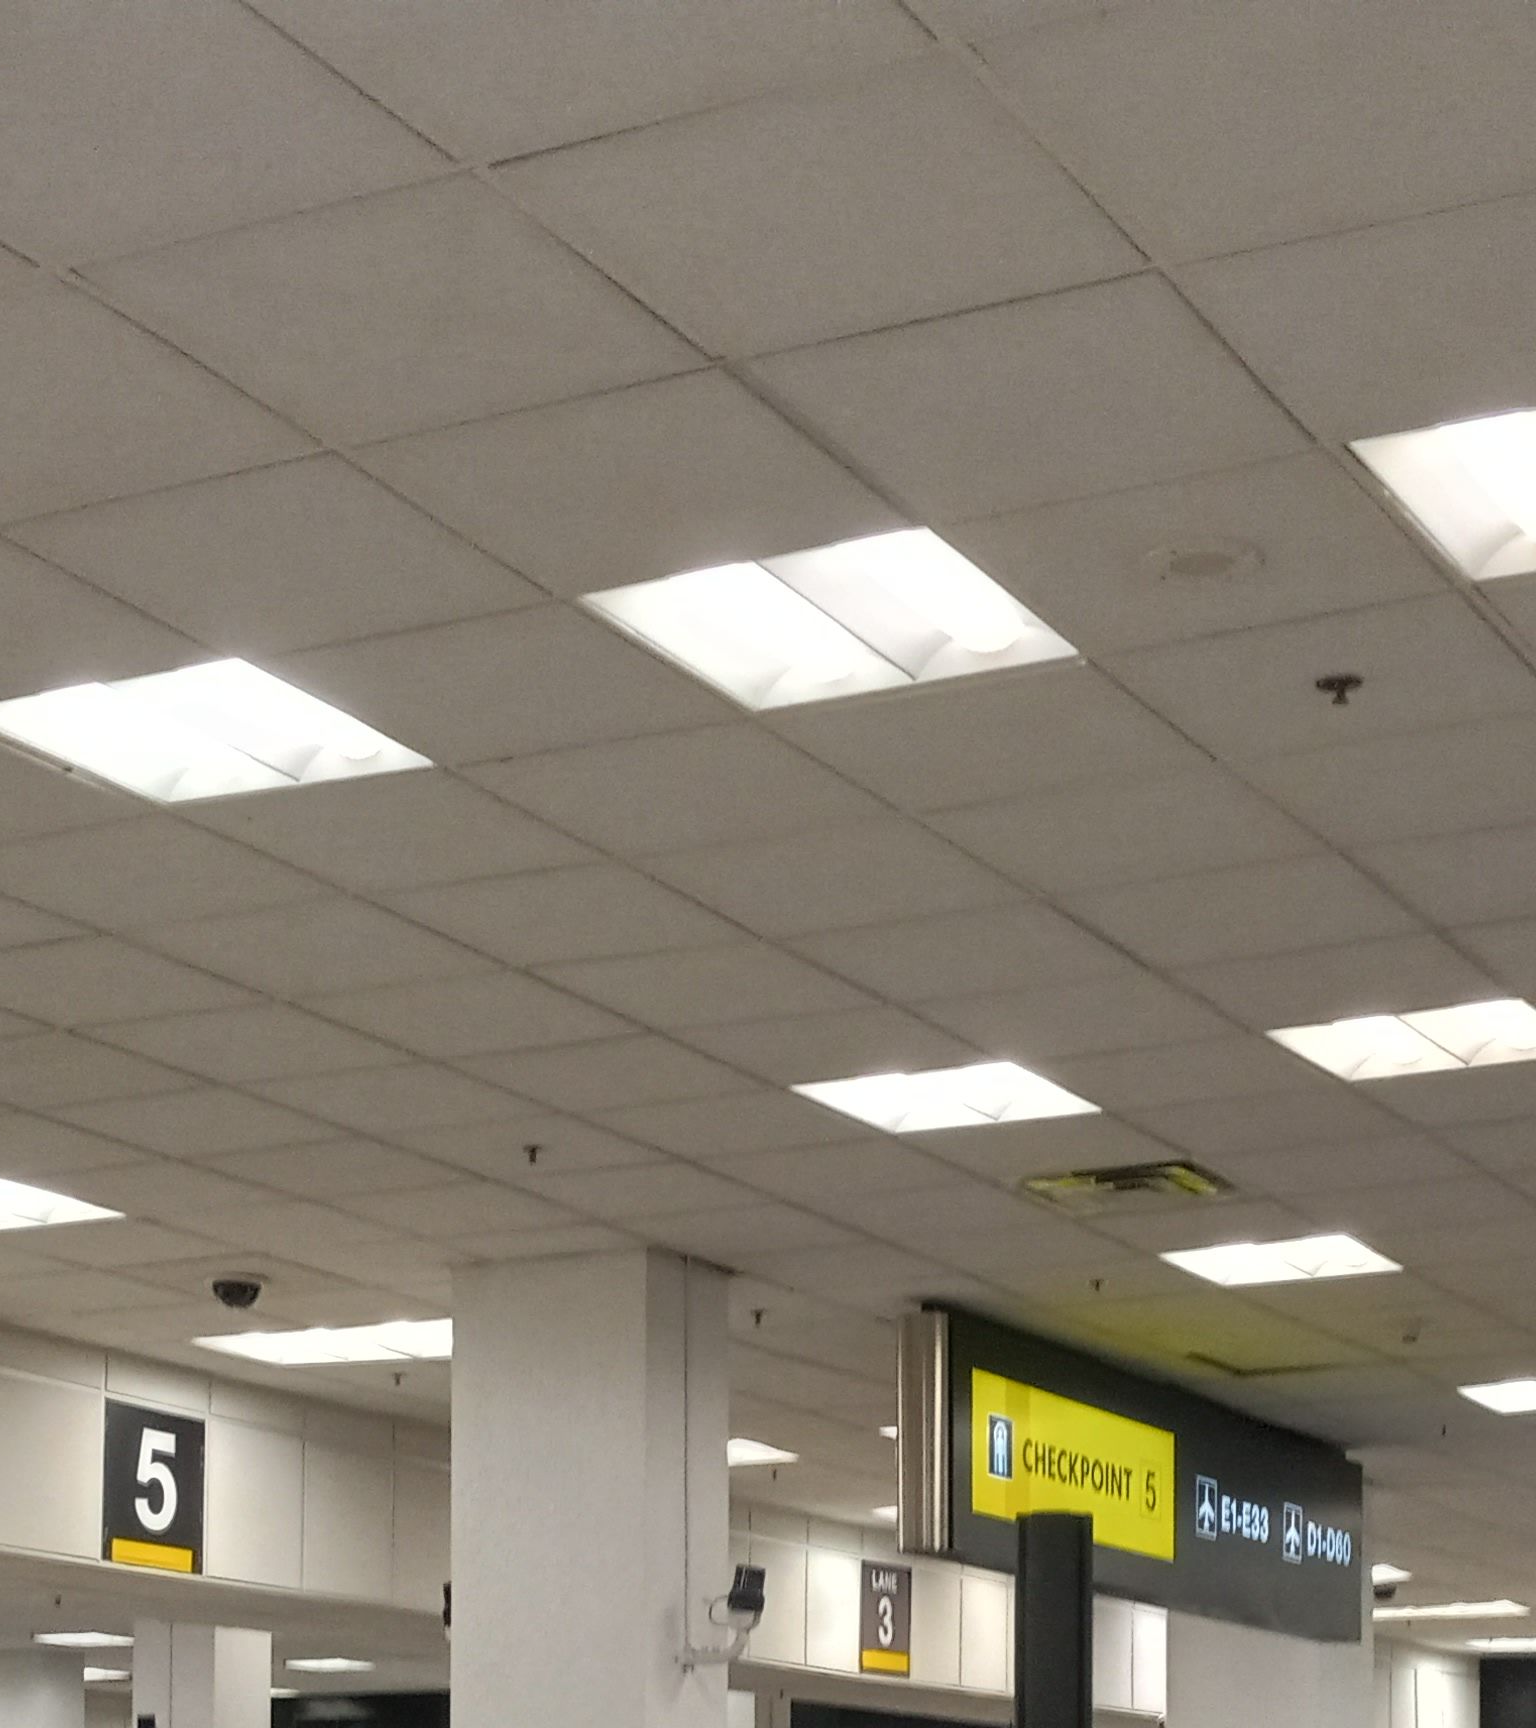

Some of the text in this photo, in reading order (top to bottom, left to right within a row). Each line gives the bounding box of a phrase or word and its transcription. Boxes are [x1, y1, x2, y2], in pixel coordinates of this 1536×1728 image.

[134, 1427, 178, 1533] 5
[1022, 1437, 1157, 1513] CHECKPOINT 5
[1221, 1494, 1270, 1544] E1-E33
[871, 1568, 898, 1595] LANE
[878, 1594, 893, 1648] 3
